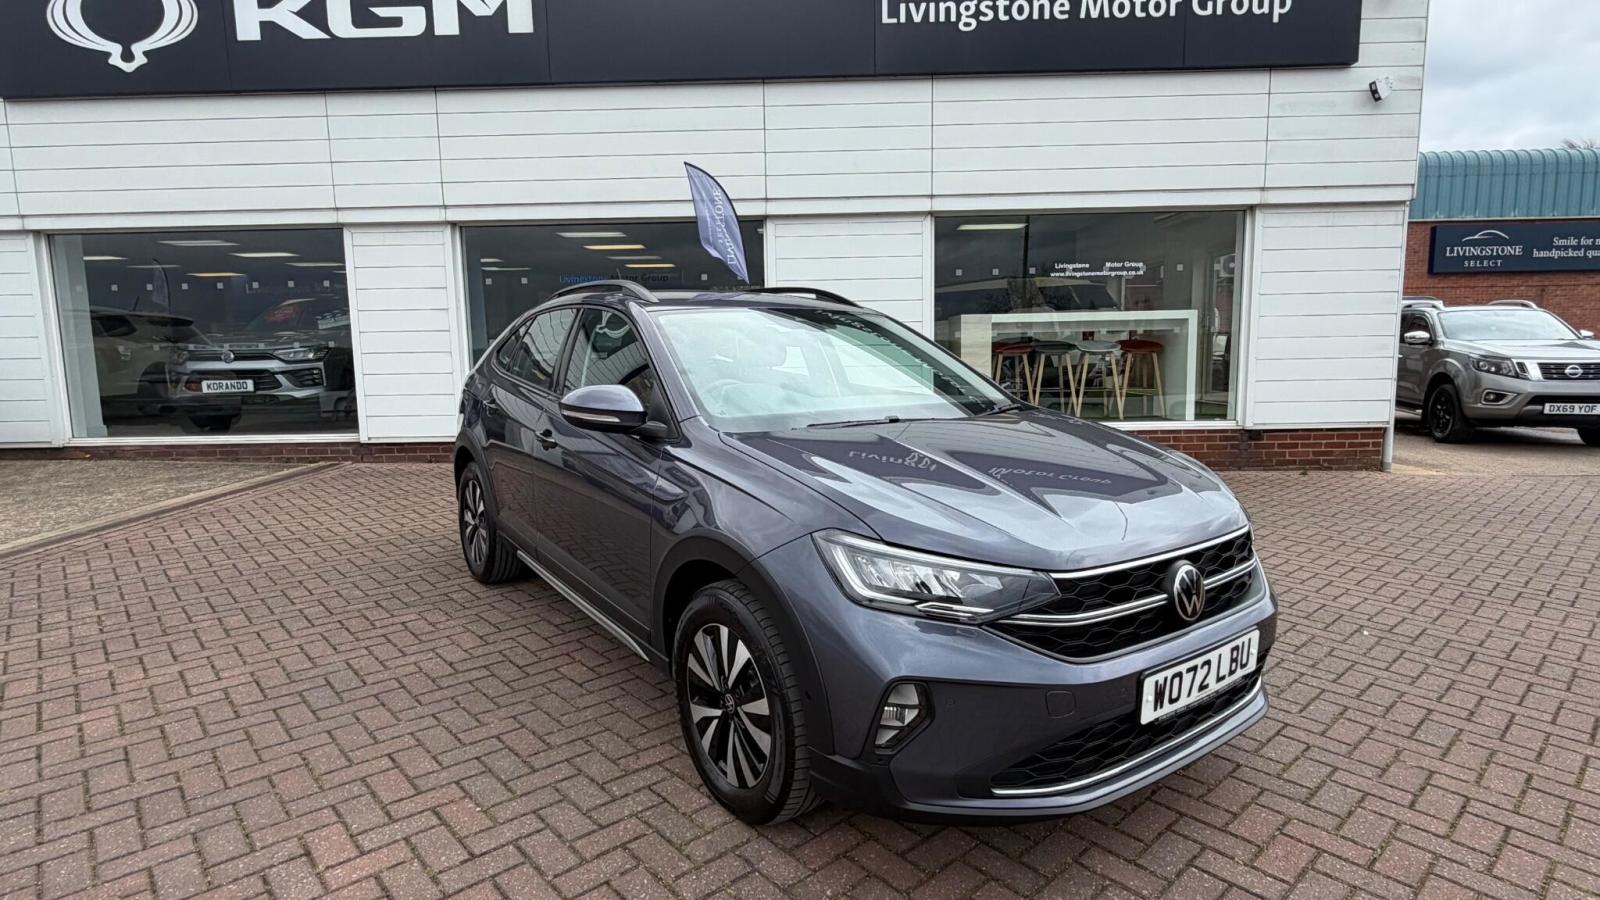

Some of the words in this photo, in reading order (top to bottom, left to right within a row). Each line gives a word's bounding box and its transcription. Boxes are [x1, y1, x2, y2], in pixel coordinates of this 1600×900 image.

[233, 0, 534, 41] KGM
[881, 0, 1071, 32] Livingstone
[1079, 0, 1183, 19] Motor
[1191, 0, 1293, 23] Group
[1552, 236, 1579, 246] Smile
[1580, 236, 1594, 246] for
[1445, 245, 1524, 257] LIVINGSTONE
[1532, 248, 1585, 259] handpicked
[1054, 262, 1090, 270] Livingstone
[1124, 261, 1144, 269] Group
[1463, 259, 1503, 267] SELECT
[206, 381, 249, 391] KORANDO
[1548, 404, 1575, 413] DX69
[1578, 404, 1598, 413] YOF
[1153, 659, 1212, 712] WO72
[1215, 637, 1252, 684] LBU
